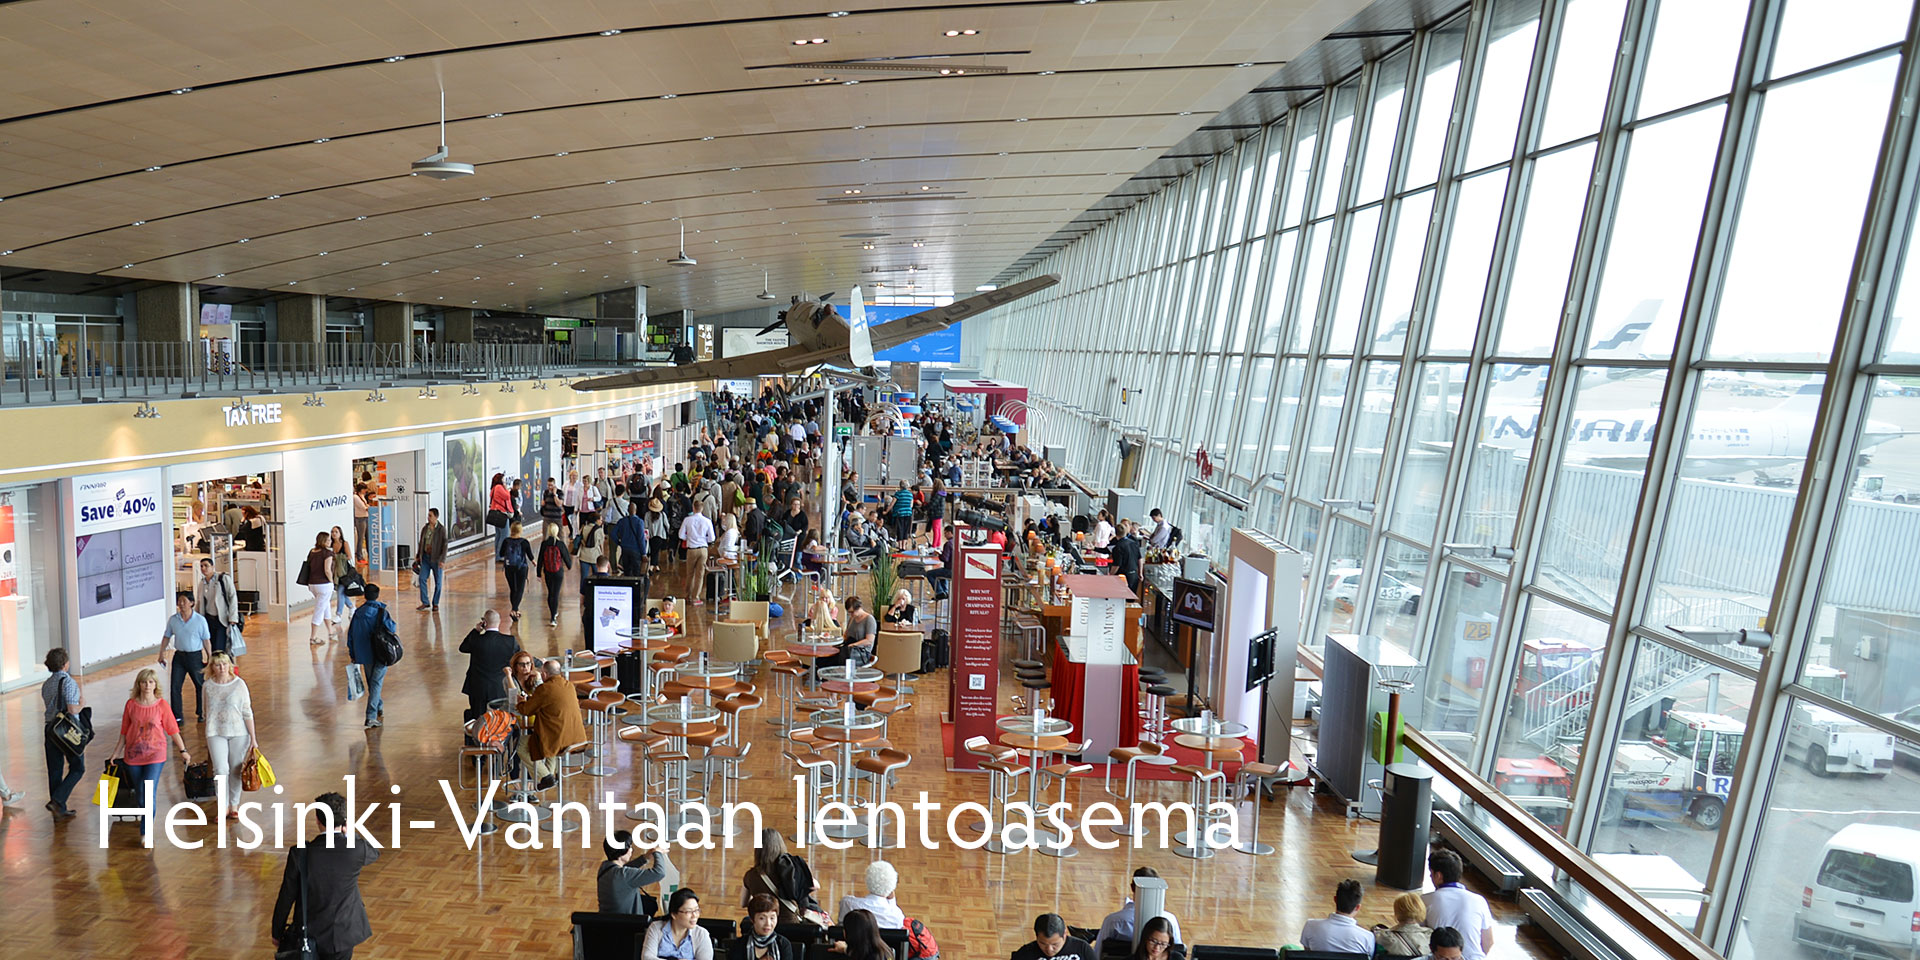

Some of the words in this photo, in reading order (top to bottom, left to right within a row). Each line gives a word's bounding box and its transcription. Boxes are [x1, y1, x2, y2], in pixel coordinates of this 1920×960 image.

[222, 405, 249, 427] TAX
[251, 403, 282, 424] FREE
[80, 482, 107, 491] FINNAIR
[81, 505, 115, 522] Save
[123, 496, 156, 515] 40%
[310, 495, 348, 511] FINNAIR
[371, 512, 380, 565] BIOTHERM
[124, 554, 141, 564] Calvin
[142, 552, 155, 561] Klein
[1381, 588, 1402, 599] 435
